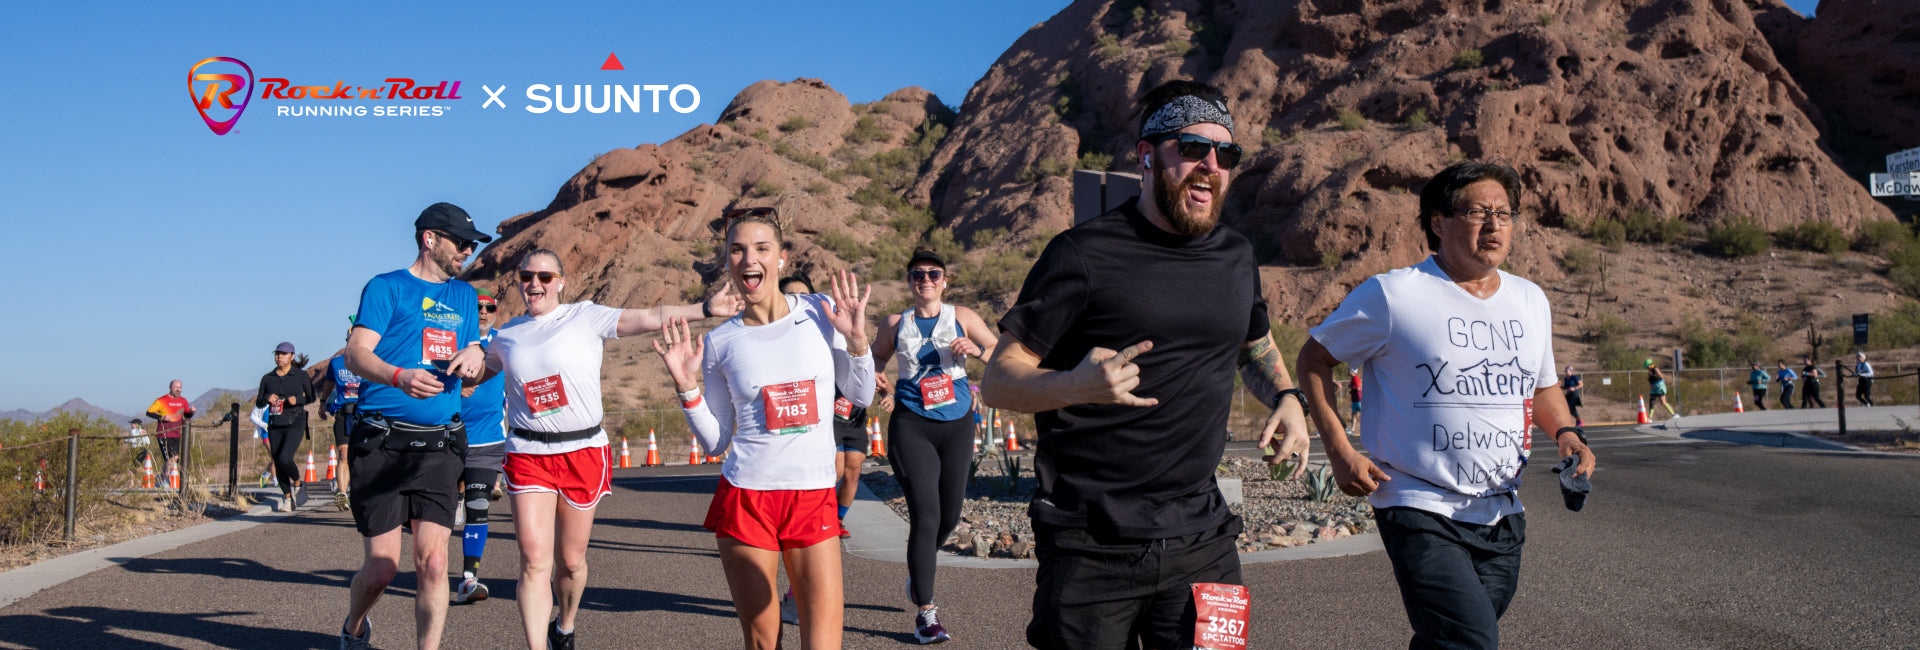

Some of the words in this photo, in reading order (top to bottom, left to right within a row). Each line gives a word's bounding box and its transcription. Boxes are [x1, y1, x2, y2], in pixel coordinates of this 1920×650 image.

[1889, 159, 1919, 174] Karsten
[1448, 317, 1523, 351] GCNP
[428, 344, 452, 355] 4835
[1416, 361, 1535, 398] Xanterra
[533, 391, 560, 406] 7535
[927, 387, 950, 399] 6263
[775, 403, 808, 418] 7183
[1207, 616, 1245, 636] 3267
